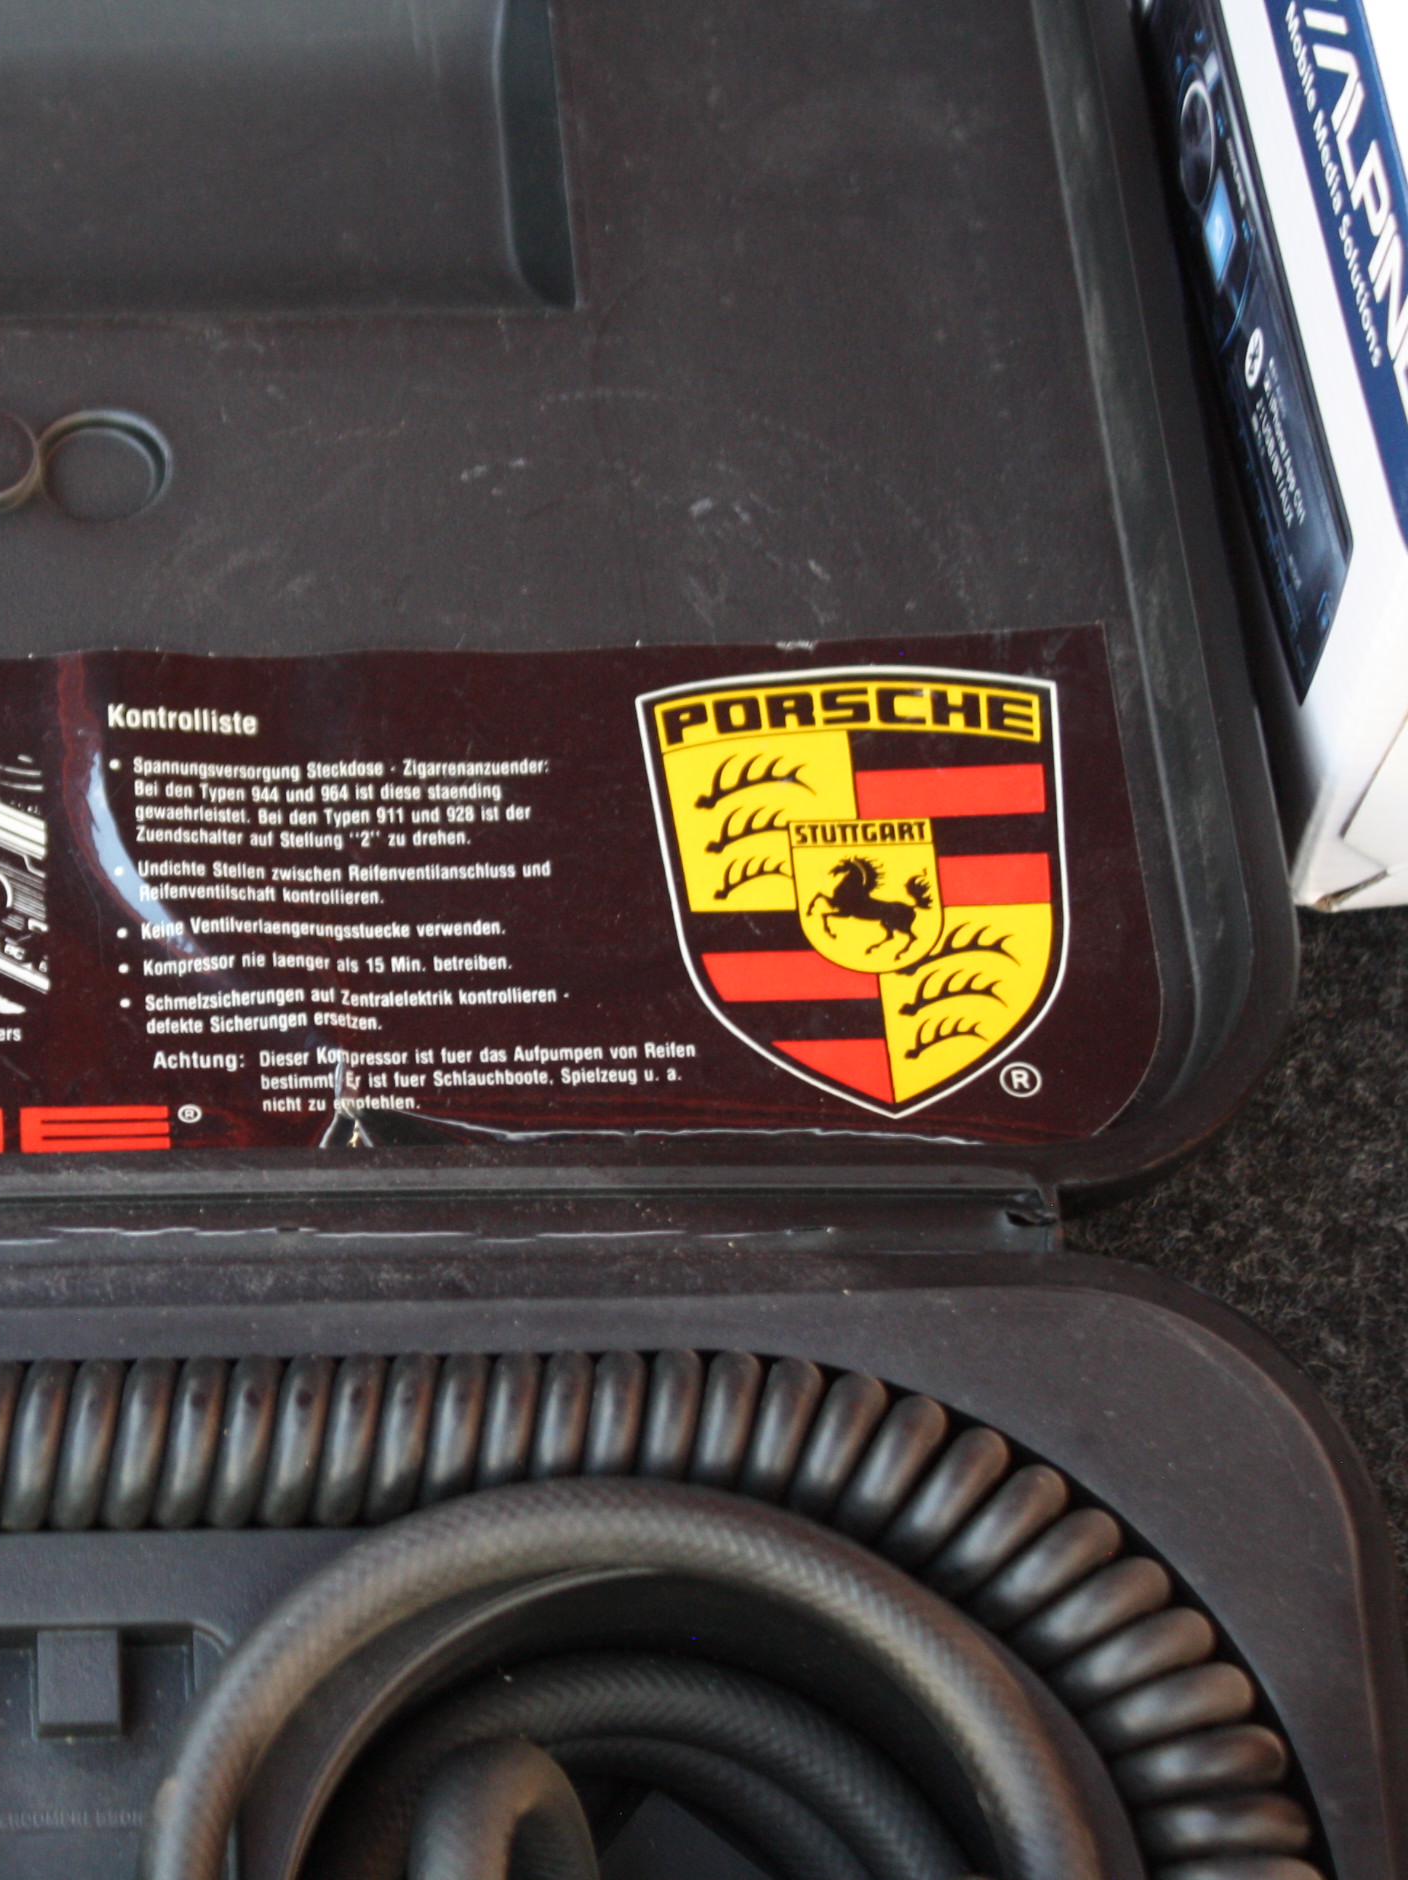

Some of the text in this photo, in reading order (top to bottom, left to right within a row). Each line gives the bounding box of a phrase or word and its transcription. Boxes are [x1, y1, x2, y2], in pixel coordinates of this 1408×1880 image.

[1286, 0, 1381, 368] Mobile Media Solutions
[108, 704, 259, 735] Kontrolliste
[662, 685, 1034, 745] PORSCHE
[132, 755, 302, 782] Spannungsversorgung
[306, 758, 385, 779] Steckdose
[402, 757, 550, 779] Zigarrenanzuender:
[133, 778, 503, 803] Bei den Typen 944 und 964 ist diese staending
[134, 803, 532, 828] gewaehrleistet. Bei den Typen 911 und 928 ist der
[135, 824, 244, 846] Zuendschalter
[249, 830, 275, 848] auf
[279, 831, 345, 851] Stellung
[387, 832, 407, 848] zu
[411, 829, 472, 847] drehen.
[795, 820, 928, 845] STUTTGART
[138, 859, 552, 882] Undichte Stellen zwischen Reifenventilanschluss und
[139, 883, 385, 906] Reifenventilschaft kontrollieren.
[140, 915, 506, 943] Keine Ventilverlaengerungsstuecke verwenden.
[142, 950, 513, 978] Kompressor nie laenger als 15 Min. betreiben.
[144, 987, 306, 1013] Schmelzsicherungen
[310, 986, 336, 1003] auf
[339, 988, 454, 1008] Zentralelektrik
[457, 986, 558, 1006] kontrollieren
[145, 1011, 383, 1035] defekte Sicherungen ersetzen.
[152, 1040, 697, 1073] Achtung: Dieser Kompressor ist fuer das Aufpumpen von Reifen
[345, 1071, 361, 1090] Er
[368, 1072, 388, 1089] ist
[393, 1071, 427, 1088] fuer
[432, 1069, 554, 1088] Schlauchboote,
[560, 1067, 639, 1087] Spielzeug
[261, 1094, 421, 1113] nicht zu empfehlen.
